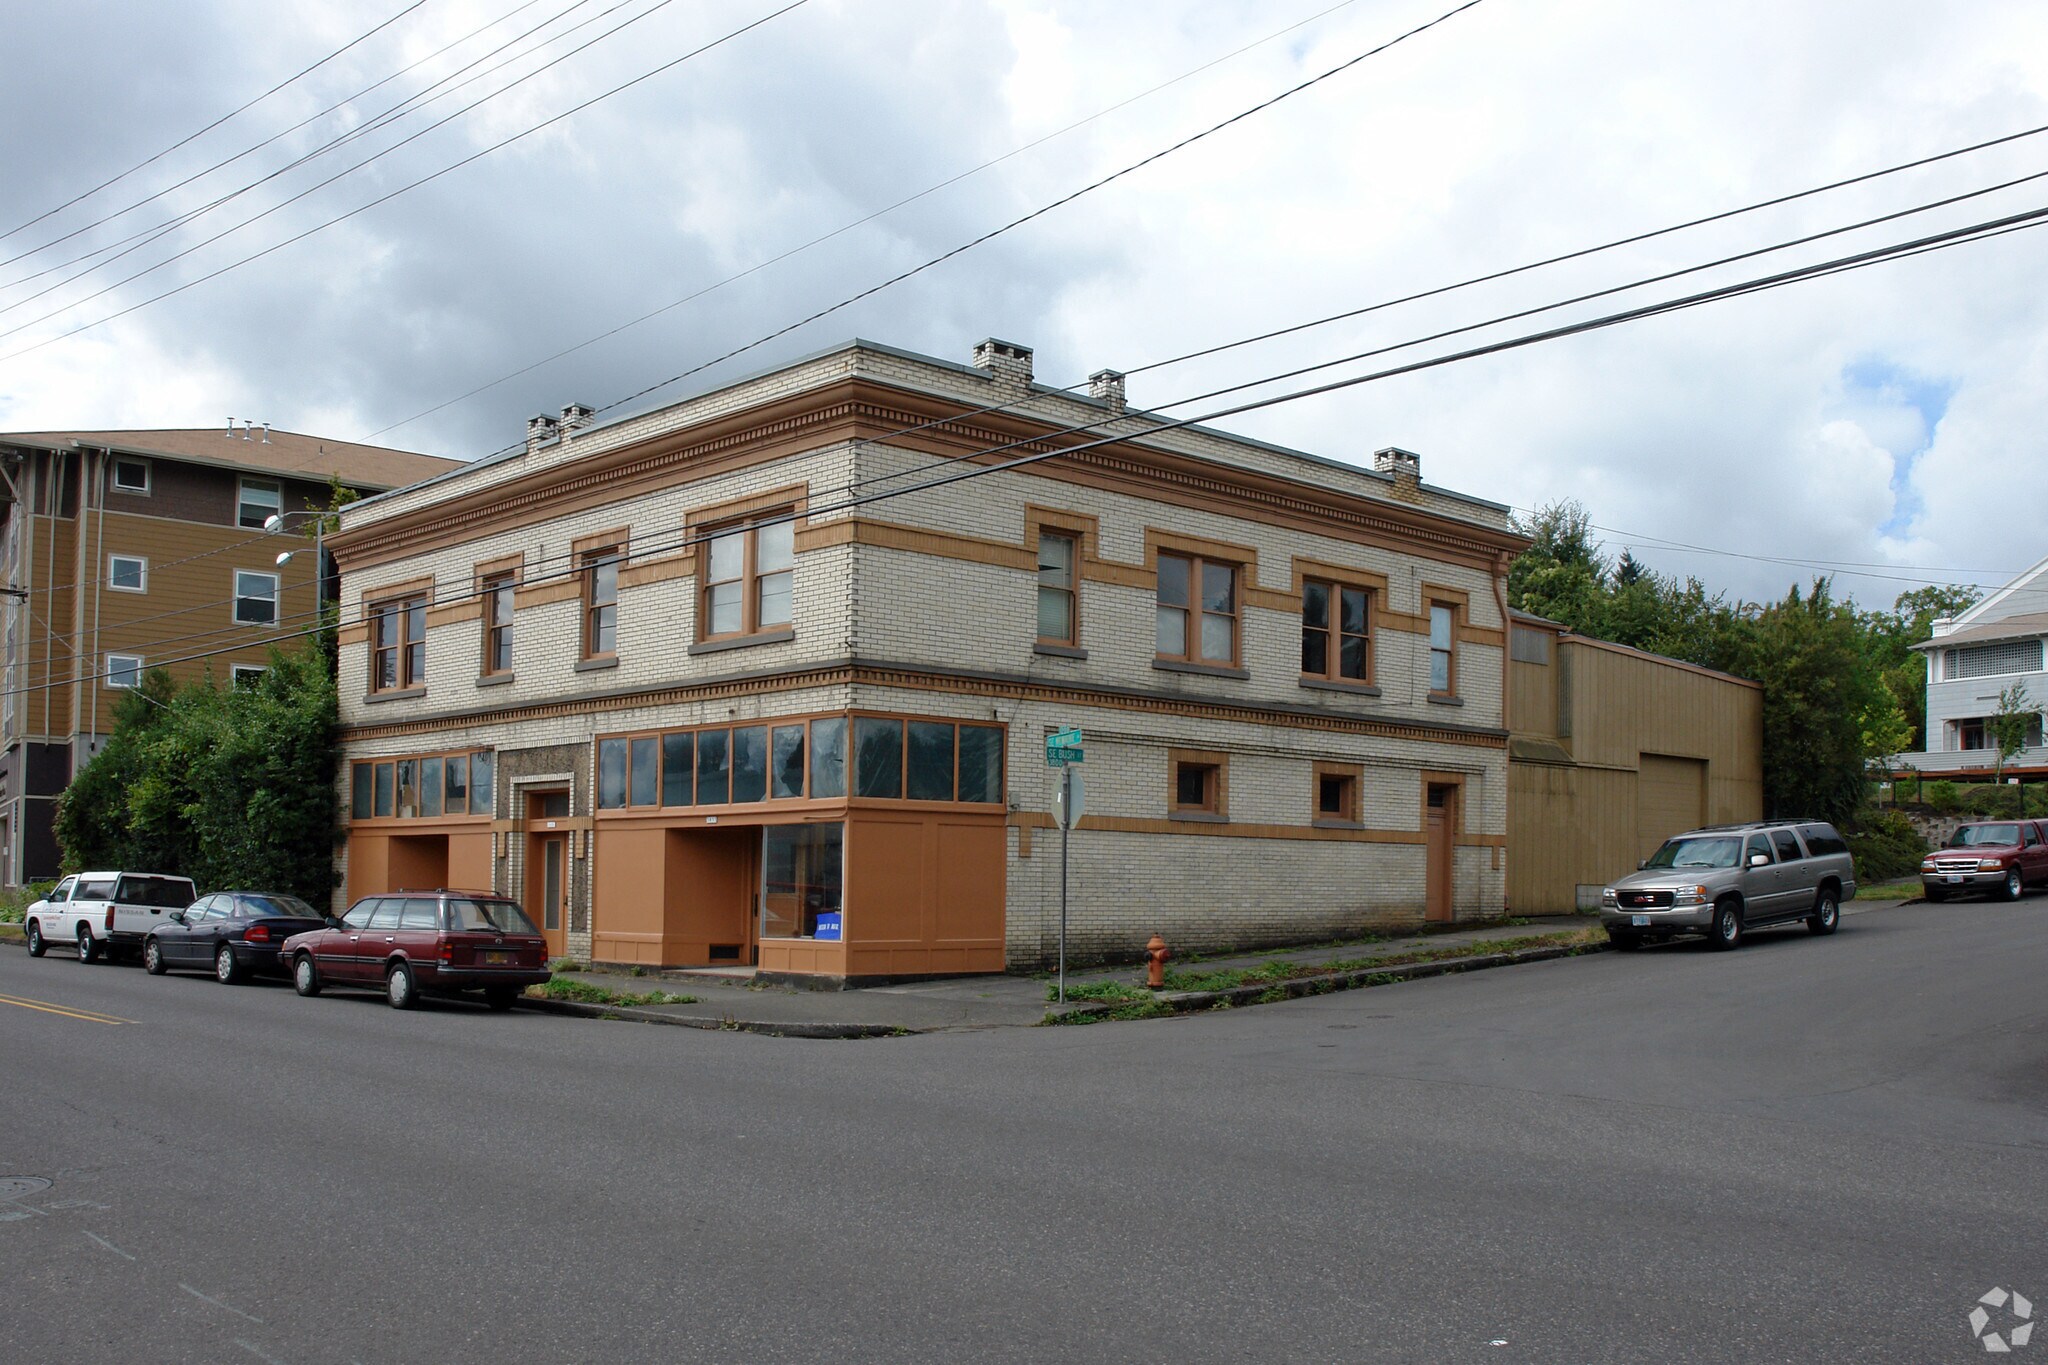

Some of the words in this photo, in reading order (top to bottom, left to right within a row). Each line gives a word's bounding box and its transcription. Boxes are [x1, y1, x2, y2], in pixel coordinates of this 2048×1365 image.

[1048, 749, 1057, 758] SE
[1058, 749, 1075, 760] BUSH
[118, 908, 144, 916] NISSAN
